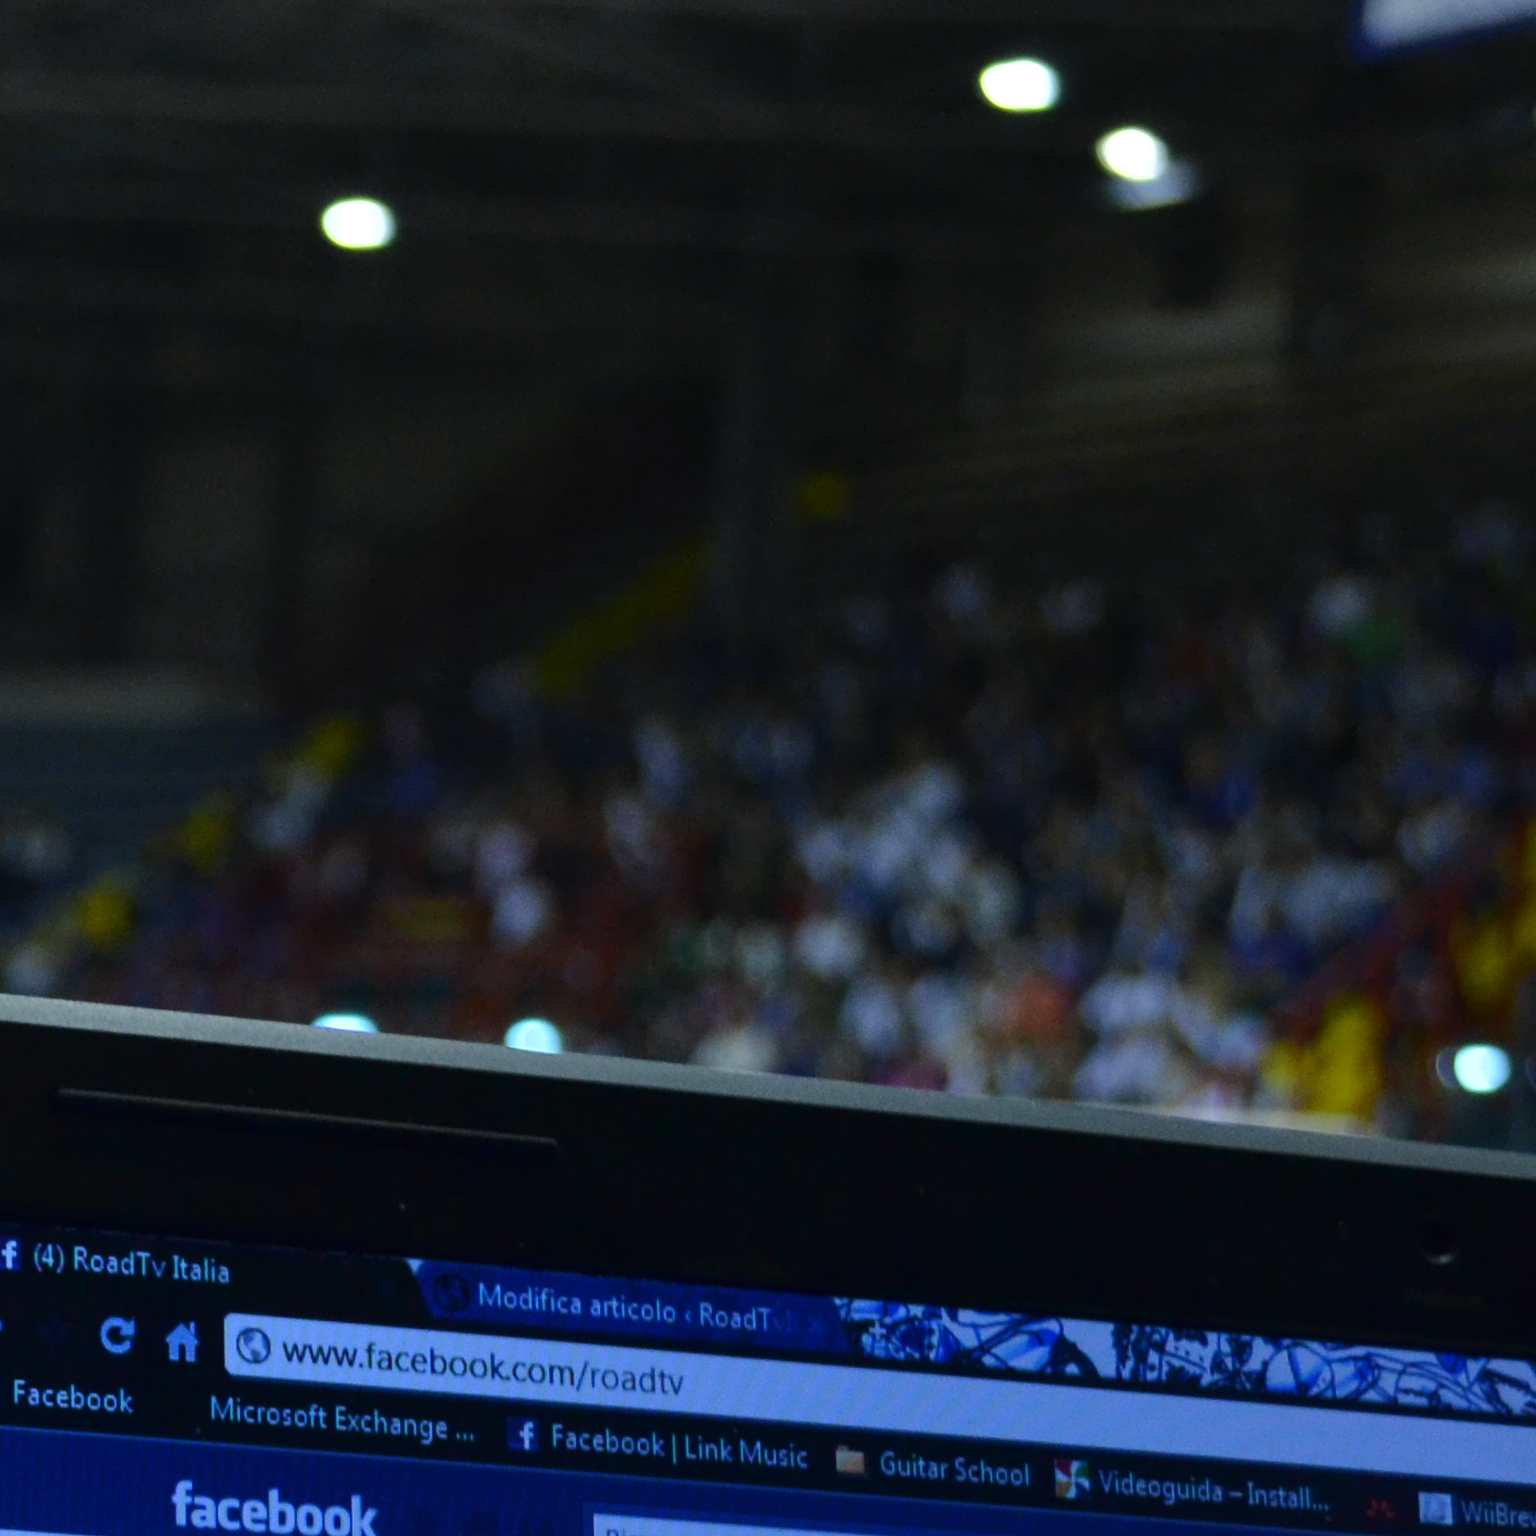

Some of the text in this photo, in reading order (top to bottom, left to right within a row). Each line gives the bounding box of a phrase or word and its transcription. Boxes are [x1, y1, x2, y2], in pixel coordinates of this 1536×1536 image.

[33, 1243, 231, 1285] (4) RoadTv Italia
[478, 1282, 583, 1316] Modifica
[589, 1297, 677, 1324] articolo
[282, 1341, 684, 1397] www.facebook.com/roadtv
[13, 1378, 133, 1414] Facebook
[210, 1394, 449, 1446] Microsoft Exchange
[551, 1422, 808, 1470] Facebook Link Music
[879, 1450, 1031, 1487] Guitar School
[1099, 1470, 1225, 1506] Videoguida
